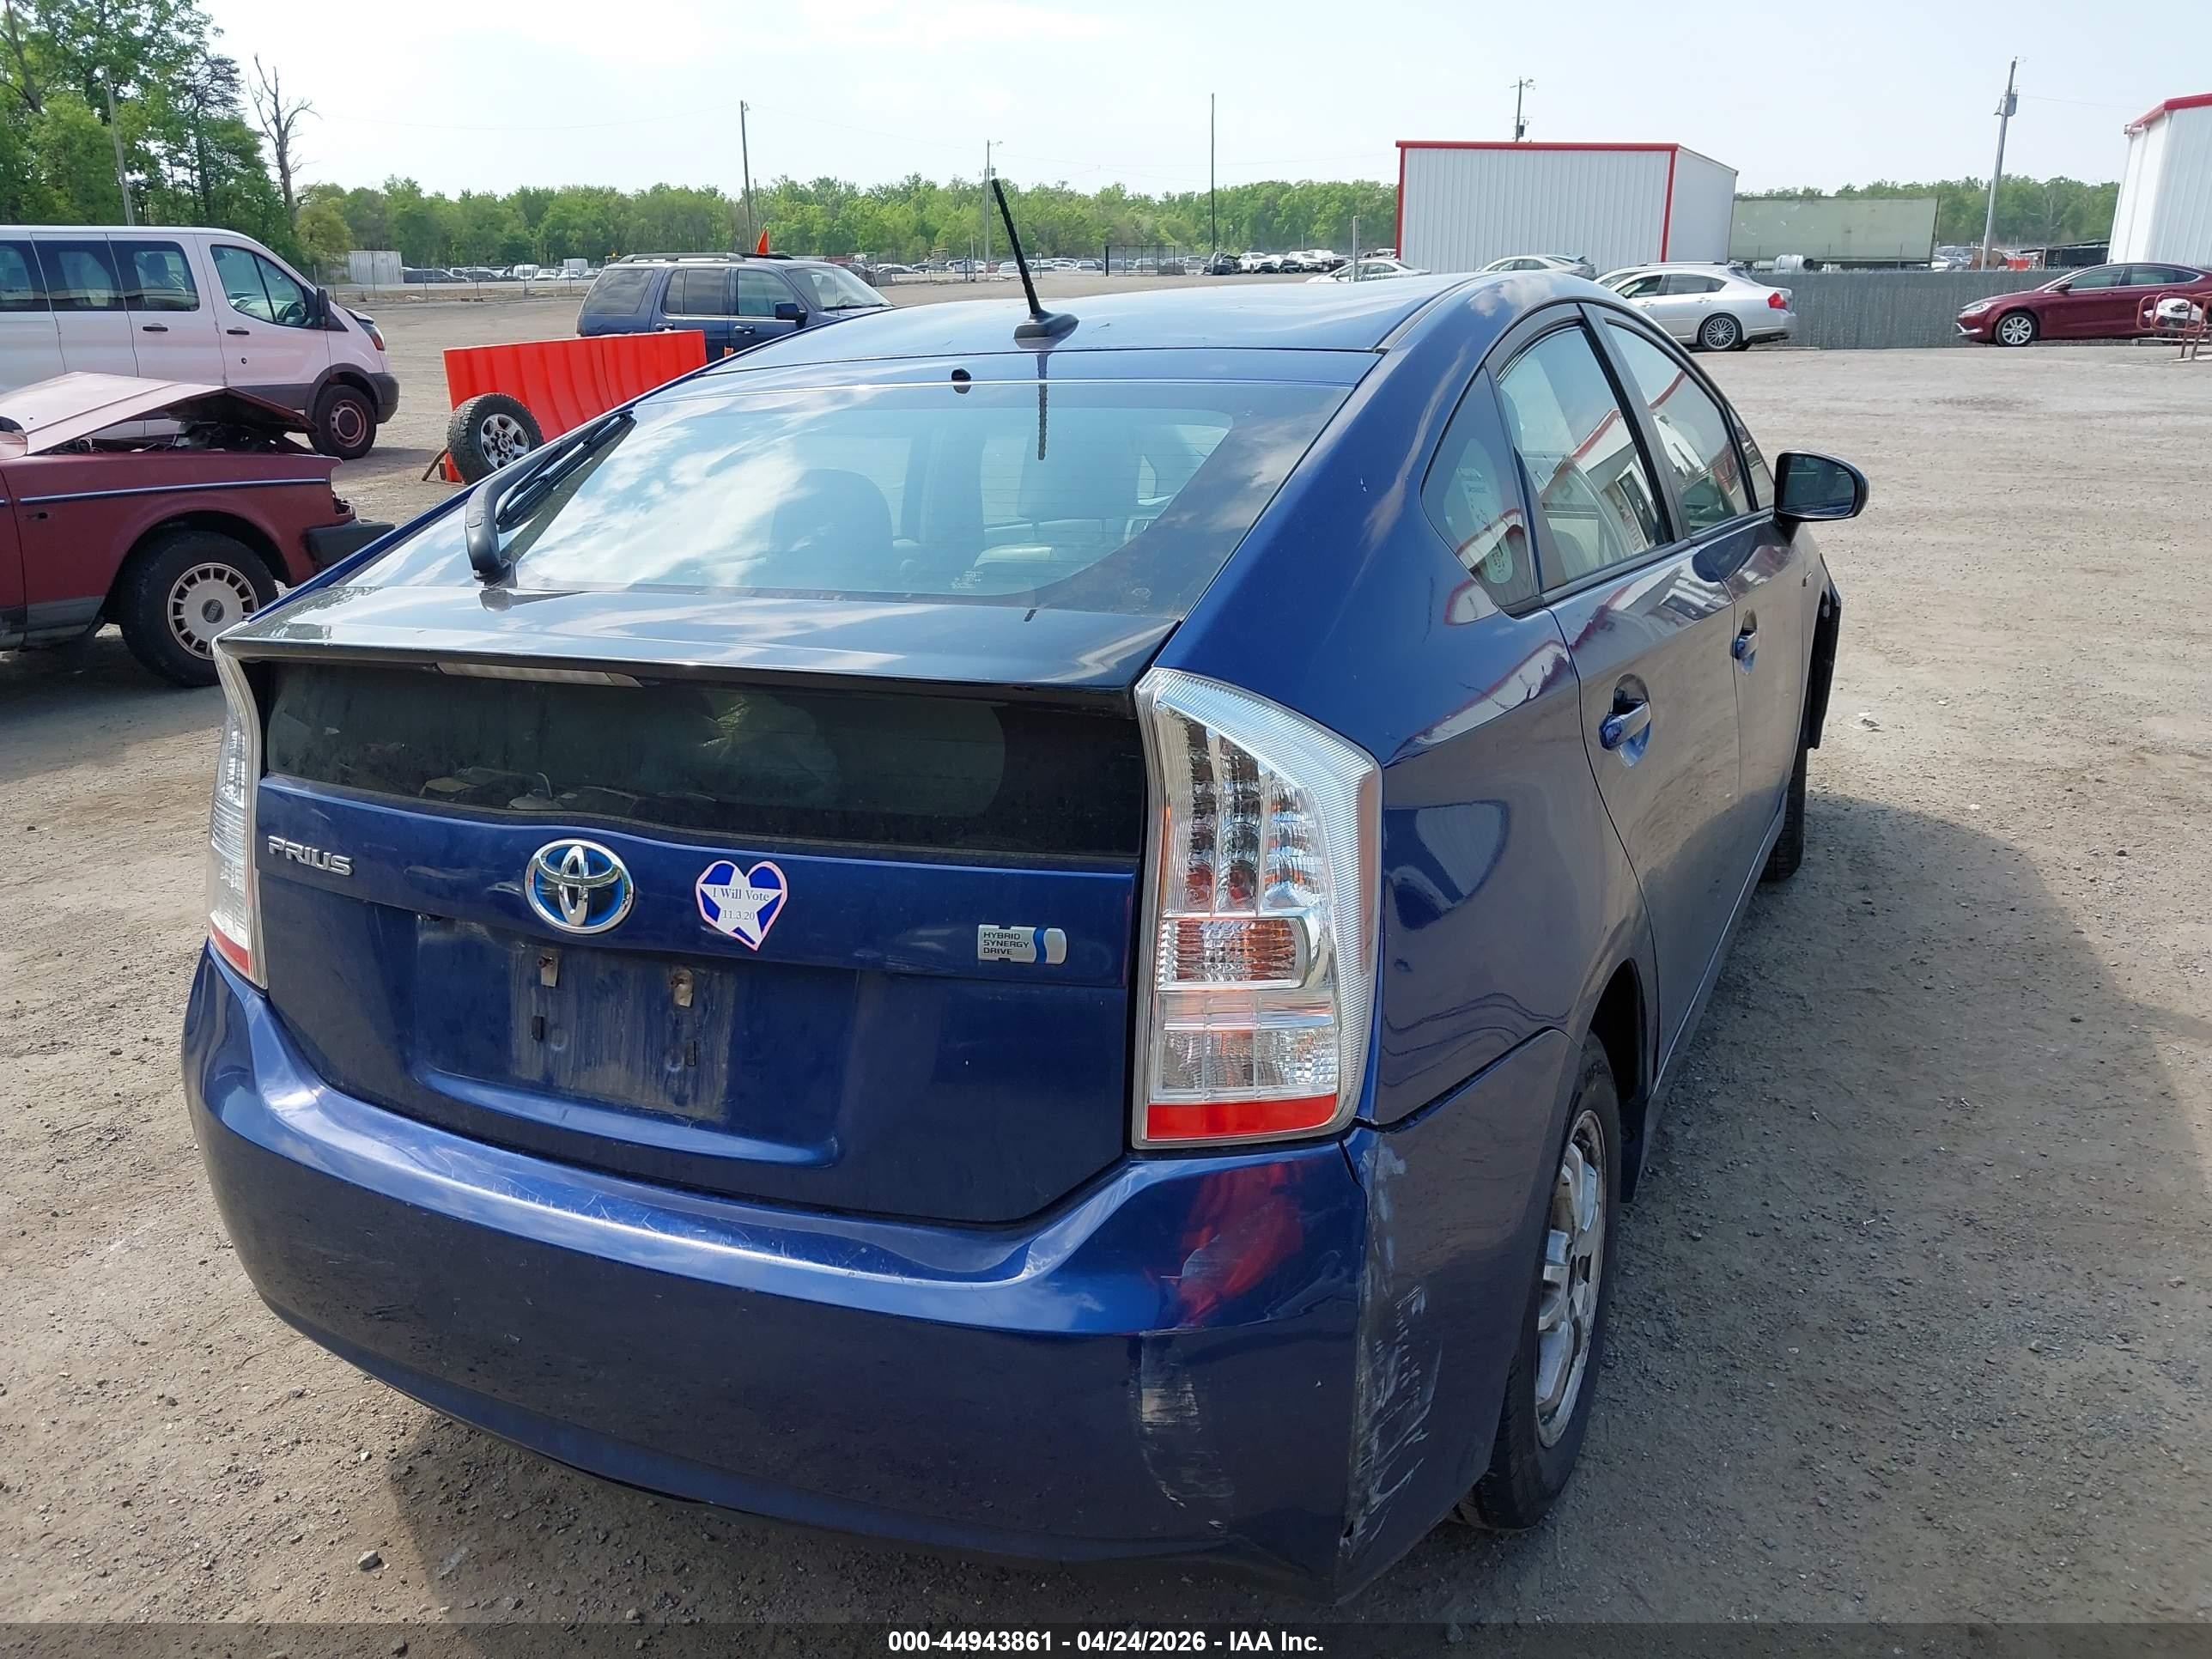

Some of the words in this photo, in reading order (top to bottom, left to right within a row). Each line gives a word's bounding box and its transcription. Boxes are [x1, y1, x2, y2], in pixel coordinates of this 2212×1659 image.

[267, 835, 353, 876] PRIUS
[712, 887, 716, 897] I
[721, 888, 742, 900] Will
[745, 890, 769, 902] Vote
[722, 909, 756, 921] 11.3.20
[983, 932, 1020, 940] HYBRID
[983, 939, 1029, 948] SYNERGY
